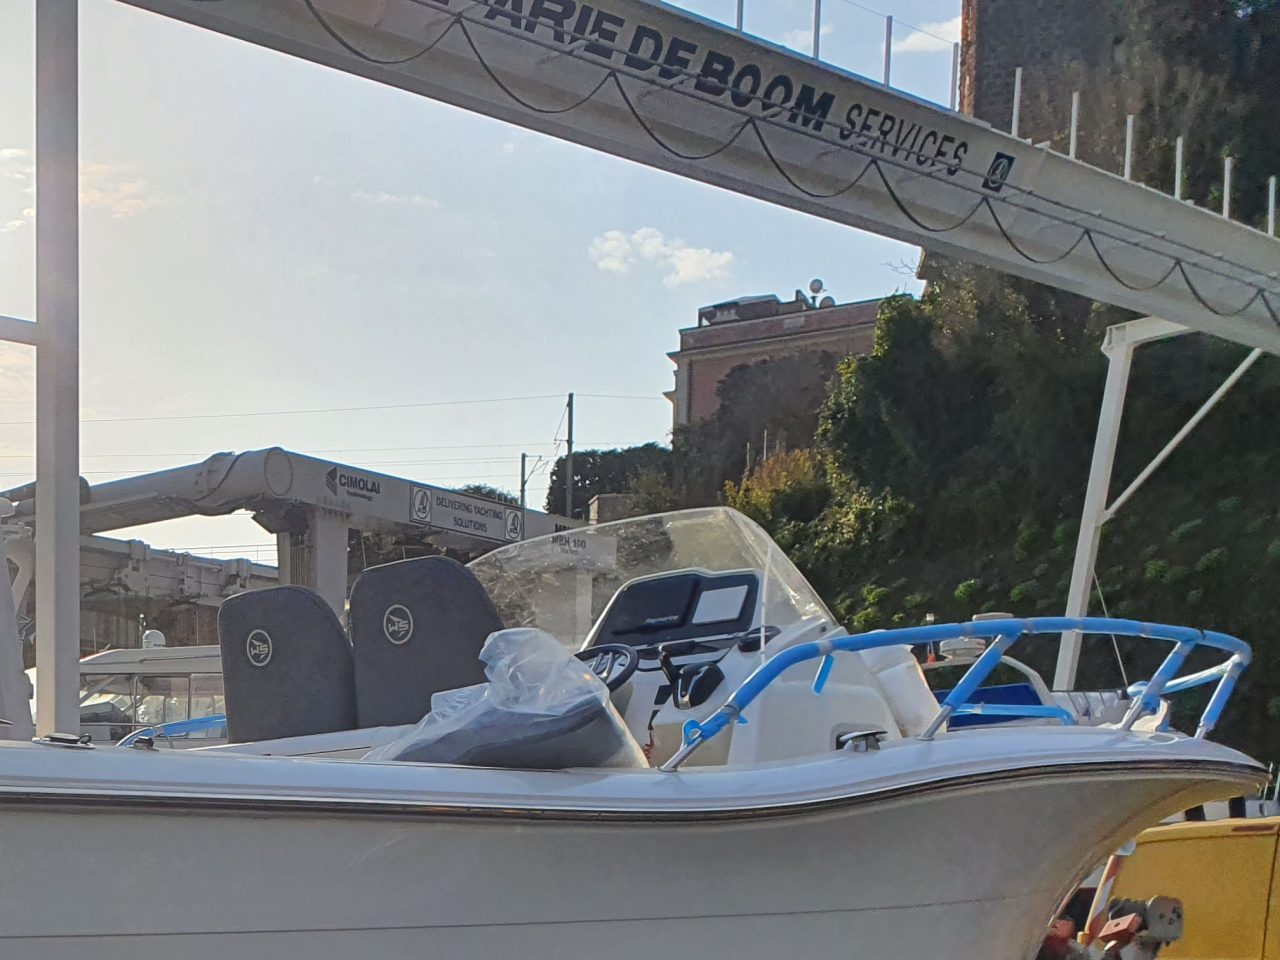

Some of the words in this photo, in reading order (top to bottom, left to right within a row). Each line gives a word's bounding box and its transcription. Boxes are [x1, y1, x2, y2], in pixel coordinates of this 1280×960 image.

[839, 103, 968, 176] SERVICES
[338, 474, 381, 495] CIMOLAI
[436, 496, 473, 515] DELIVERING
[473, 503, 503, 521] YACHTING
[453, 516, 488, 533] SOLUTIONS
